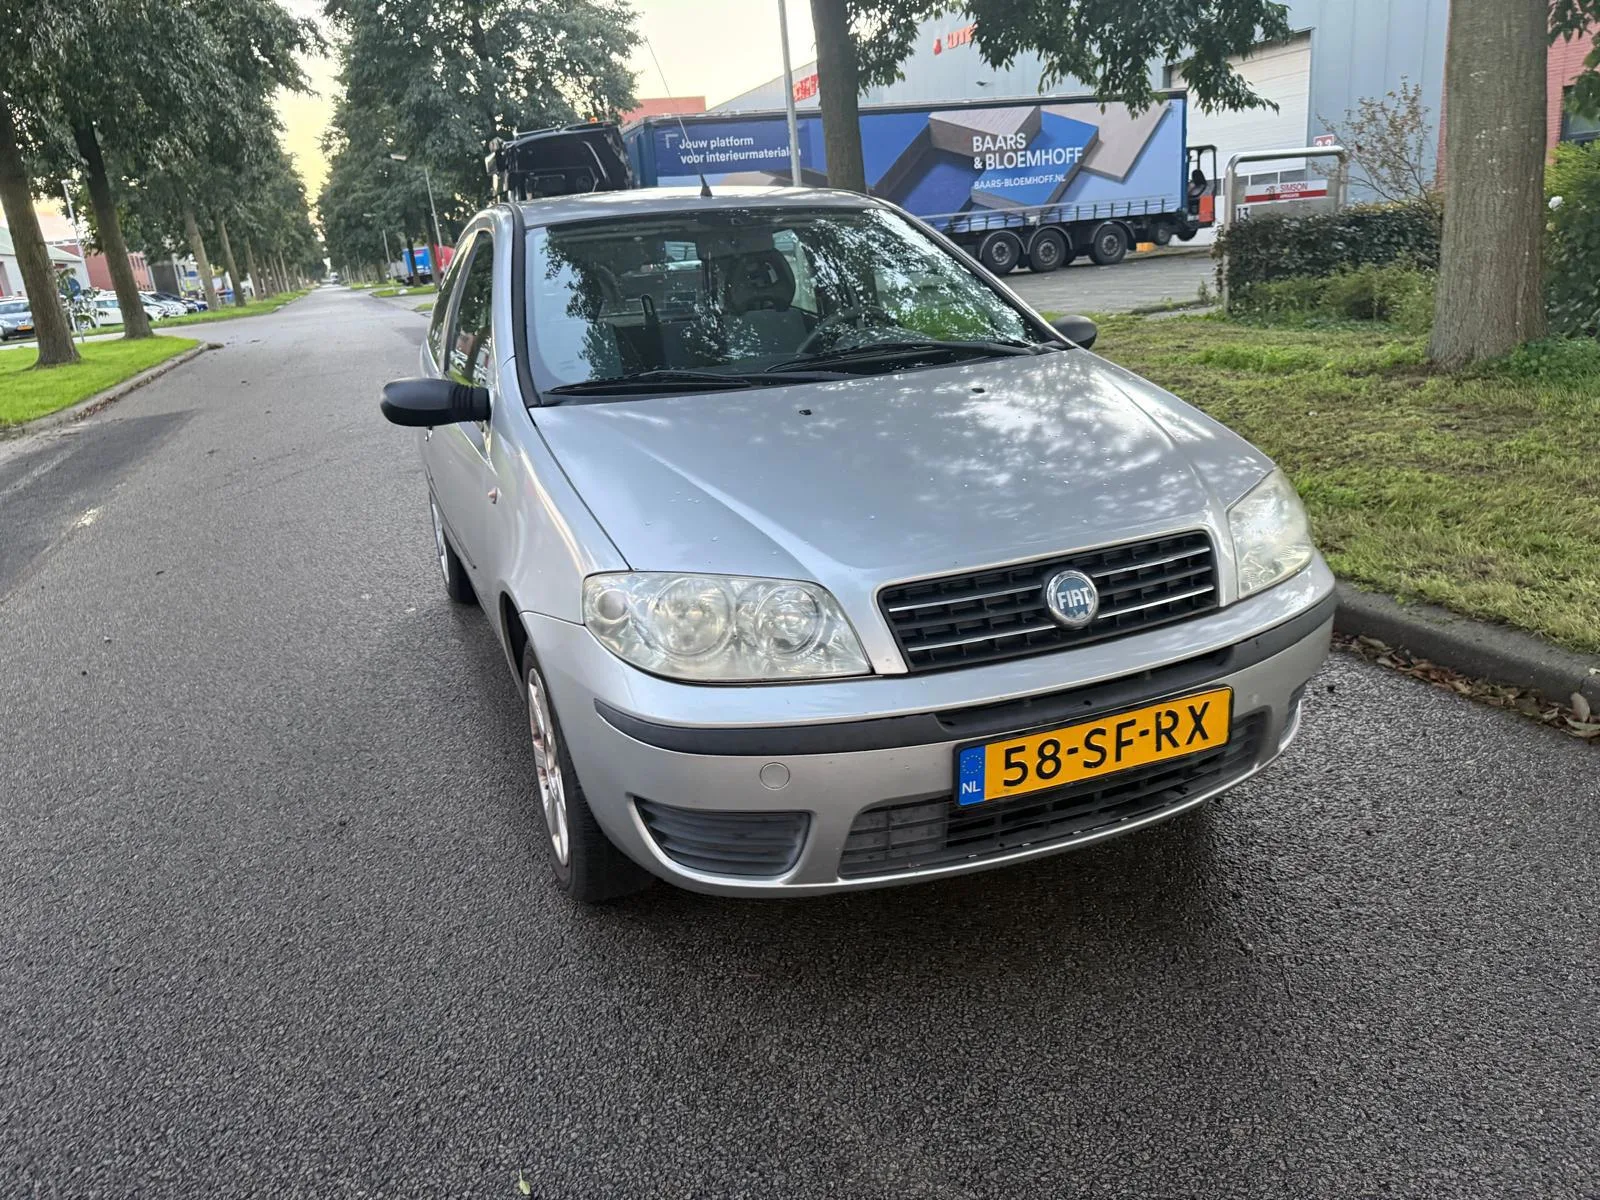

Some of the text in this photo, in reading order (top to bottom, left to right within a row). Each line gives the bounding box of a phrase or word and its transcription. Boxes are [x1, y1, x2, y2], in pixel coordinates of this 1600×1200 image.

[679, 136, 754, 150] Jouw platform
[972, 133, 1027, 153] BAARS
[681, 146, 801, 164] voor interieurmaterial
[973, 147, 1083, 171] & BLOEMHOFF
[974, 174, 1066, 190] BAARS-BLOEMHOFF.NL
[1057, 587, 1090, 610] FIAT
[1003, 701, 1211, 787] 58-SF-RX
[962, 780, 981, 795] NL
